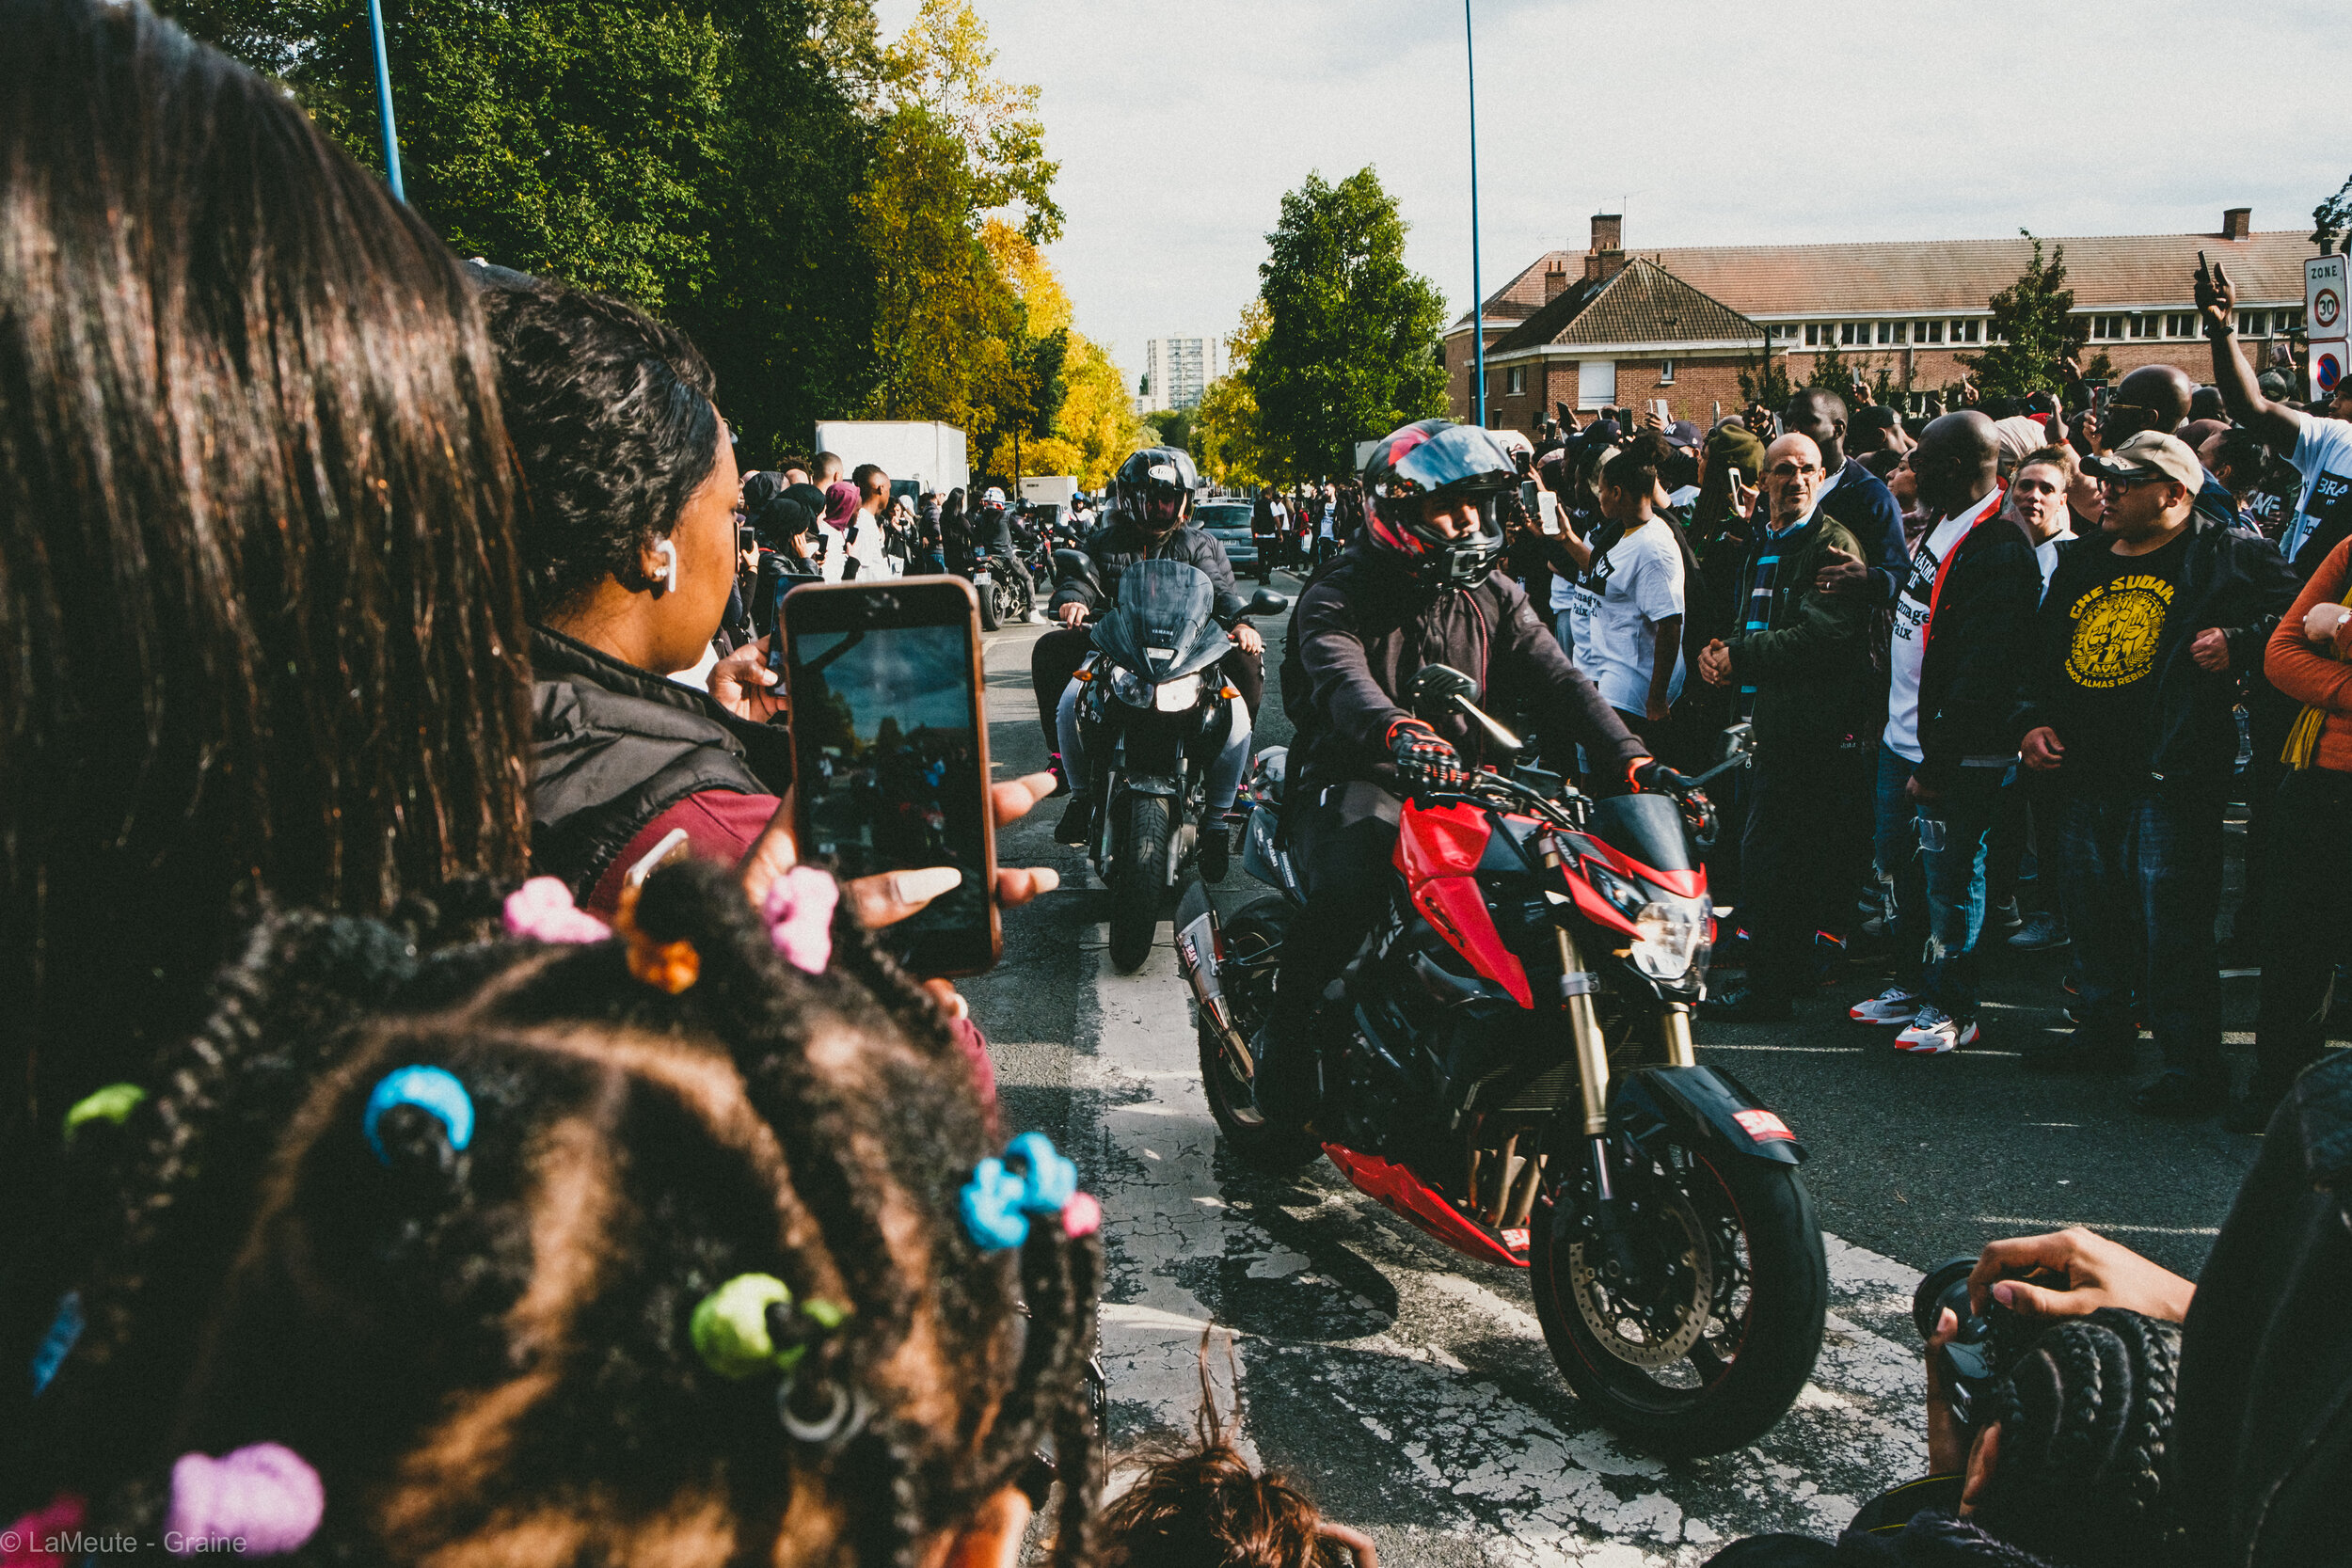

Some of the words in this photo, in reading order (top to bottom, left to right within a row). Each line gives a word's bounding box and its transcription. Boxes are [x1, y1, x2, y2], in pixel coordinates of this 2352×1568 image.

[2311, 265, 2338, 279] ZONE
[2319, 299, 2335, 316] 30
[2070, 585, 2105, 620] CHE
[1152, 628, 1173, 637] YAMAHA
[2081, 677, 2116, 689] ALMAS
[1266, 837, 1279, 867] SUZUKI
